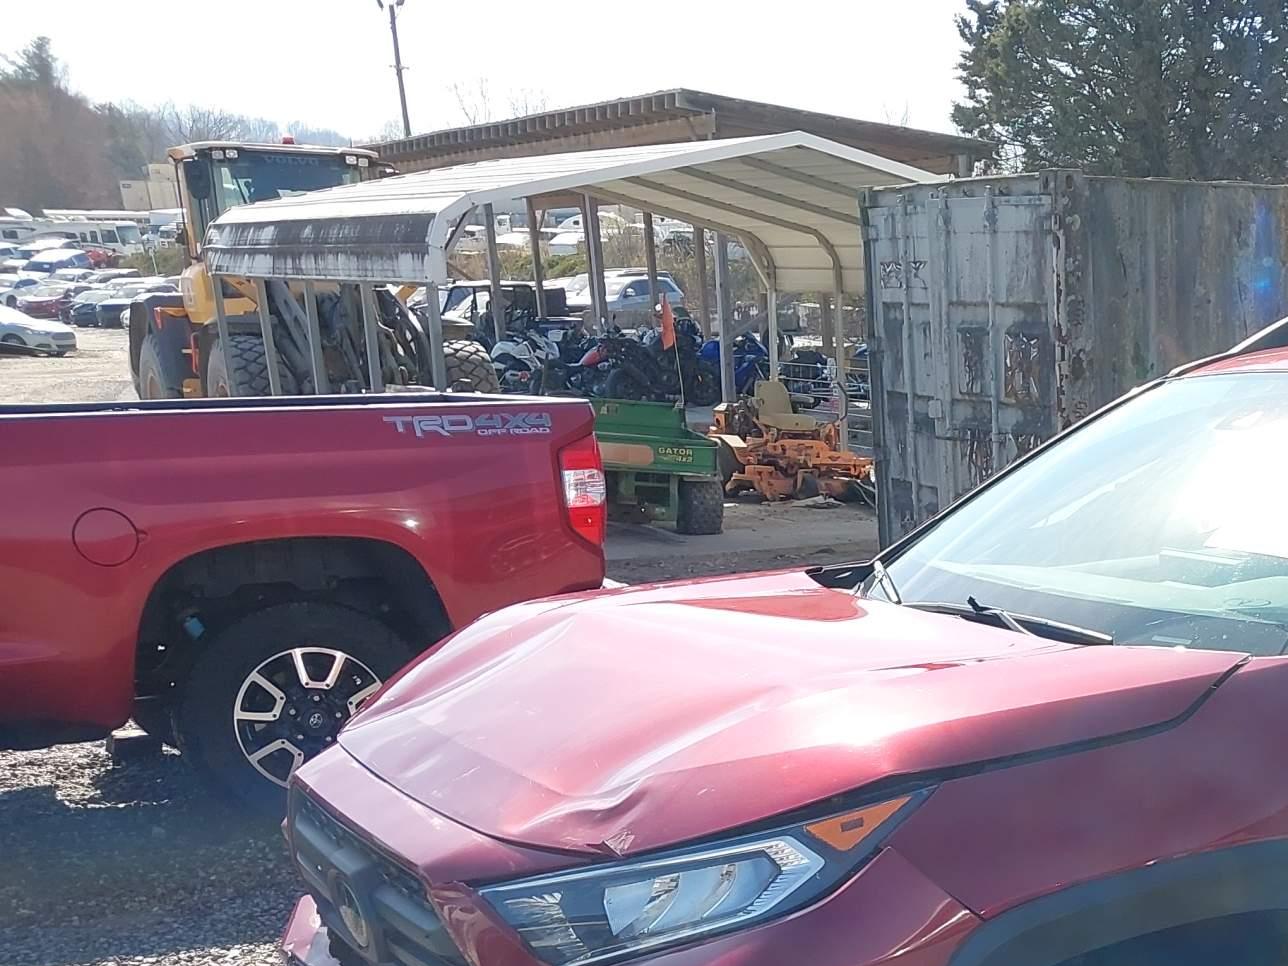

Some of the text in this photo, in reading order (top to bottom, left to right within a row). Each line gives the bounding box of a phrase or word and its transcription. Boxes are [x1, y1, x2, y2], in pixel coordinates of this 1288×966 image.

[383, 412, 552, 437] TRD 4X4
[477, 427, 550, 436] OFF ROAD
[658, 447, 693, 456] GATOR
